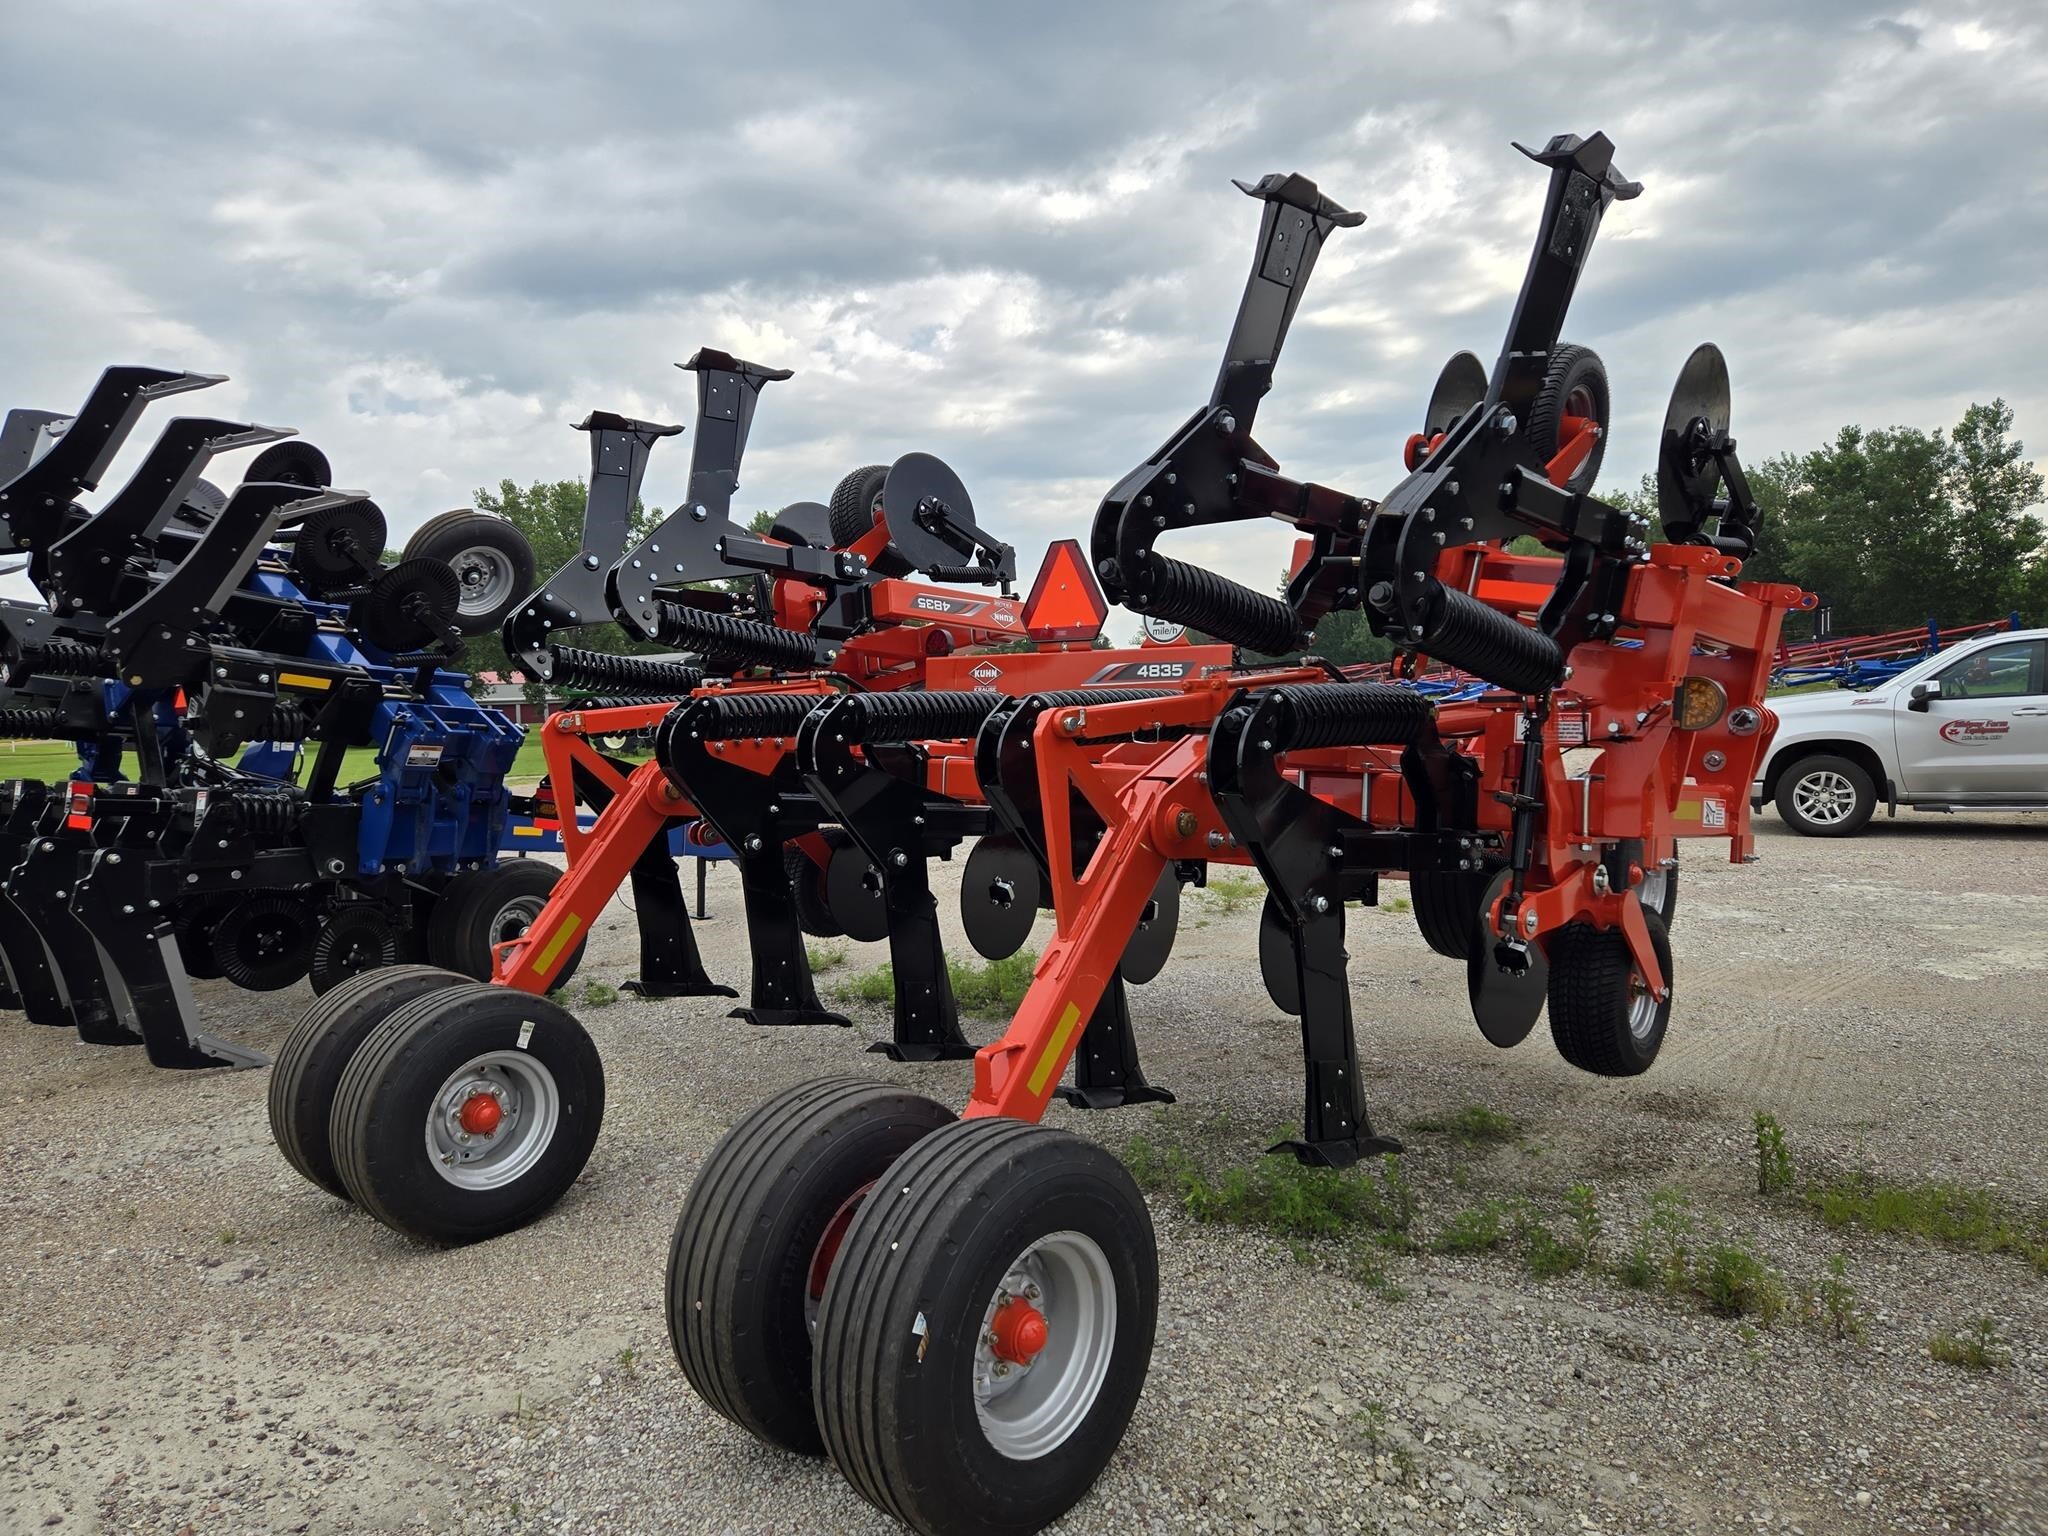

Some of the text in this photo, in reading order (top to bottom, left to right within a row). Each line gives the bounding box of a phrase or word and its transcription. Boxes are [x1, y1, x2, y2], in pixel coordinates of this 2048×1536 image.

[917, 597, 951, 612] 4835
[994, 612, 1014, 623] KUHN
[1153, 626, 1178, 636] mile/h
[974, 669, 998, 678] KUHN
[1136, 663, 1183, 678] 4835
